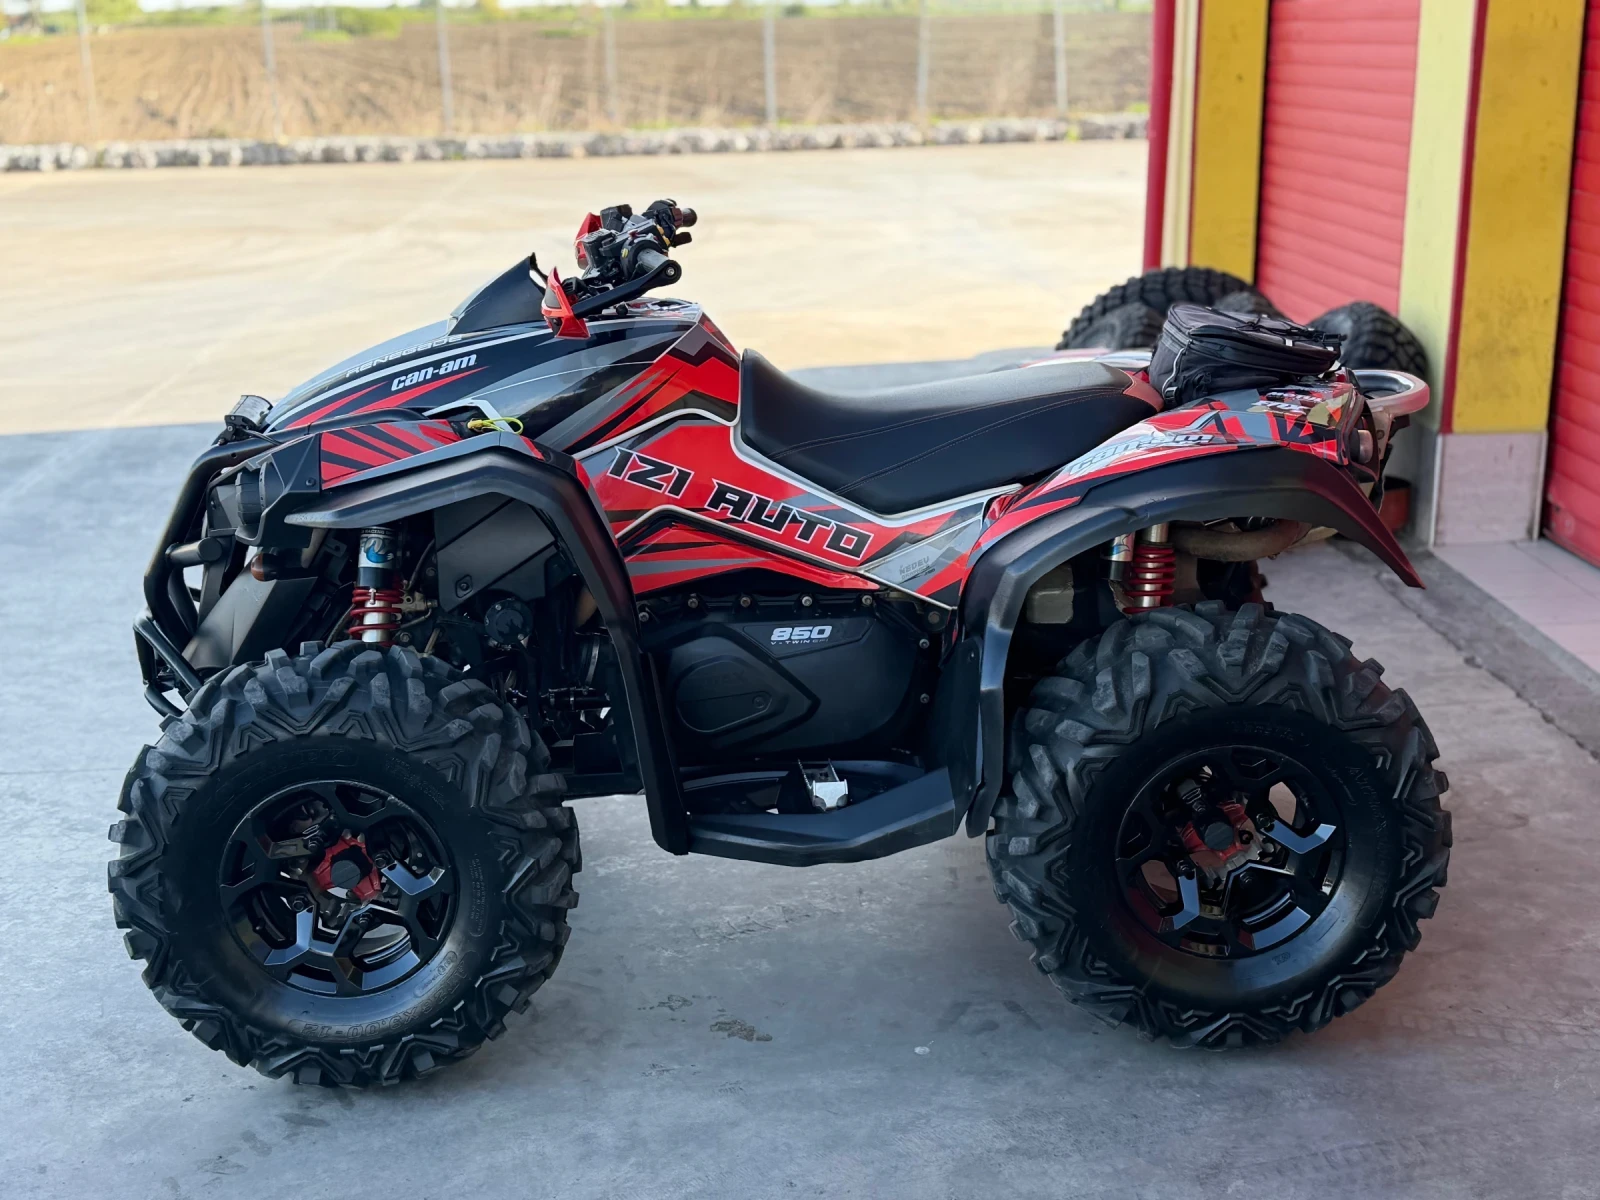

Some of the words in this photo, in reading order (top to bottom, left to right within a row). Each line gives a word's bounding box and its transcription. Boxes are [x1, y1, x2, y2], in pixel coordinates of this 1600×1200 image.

[391, 354, 477, 391] can-am
[607, 446, 694, 498] IZI
[704, 478, 874, 560] AUTO
[770, 625, 832, 640] 850
